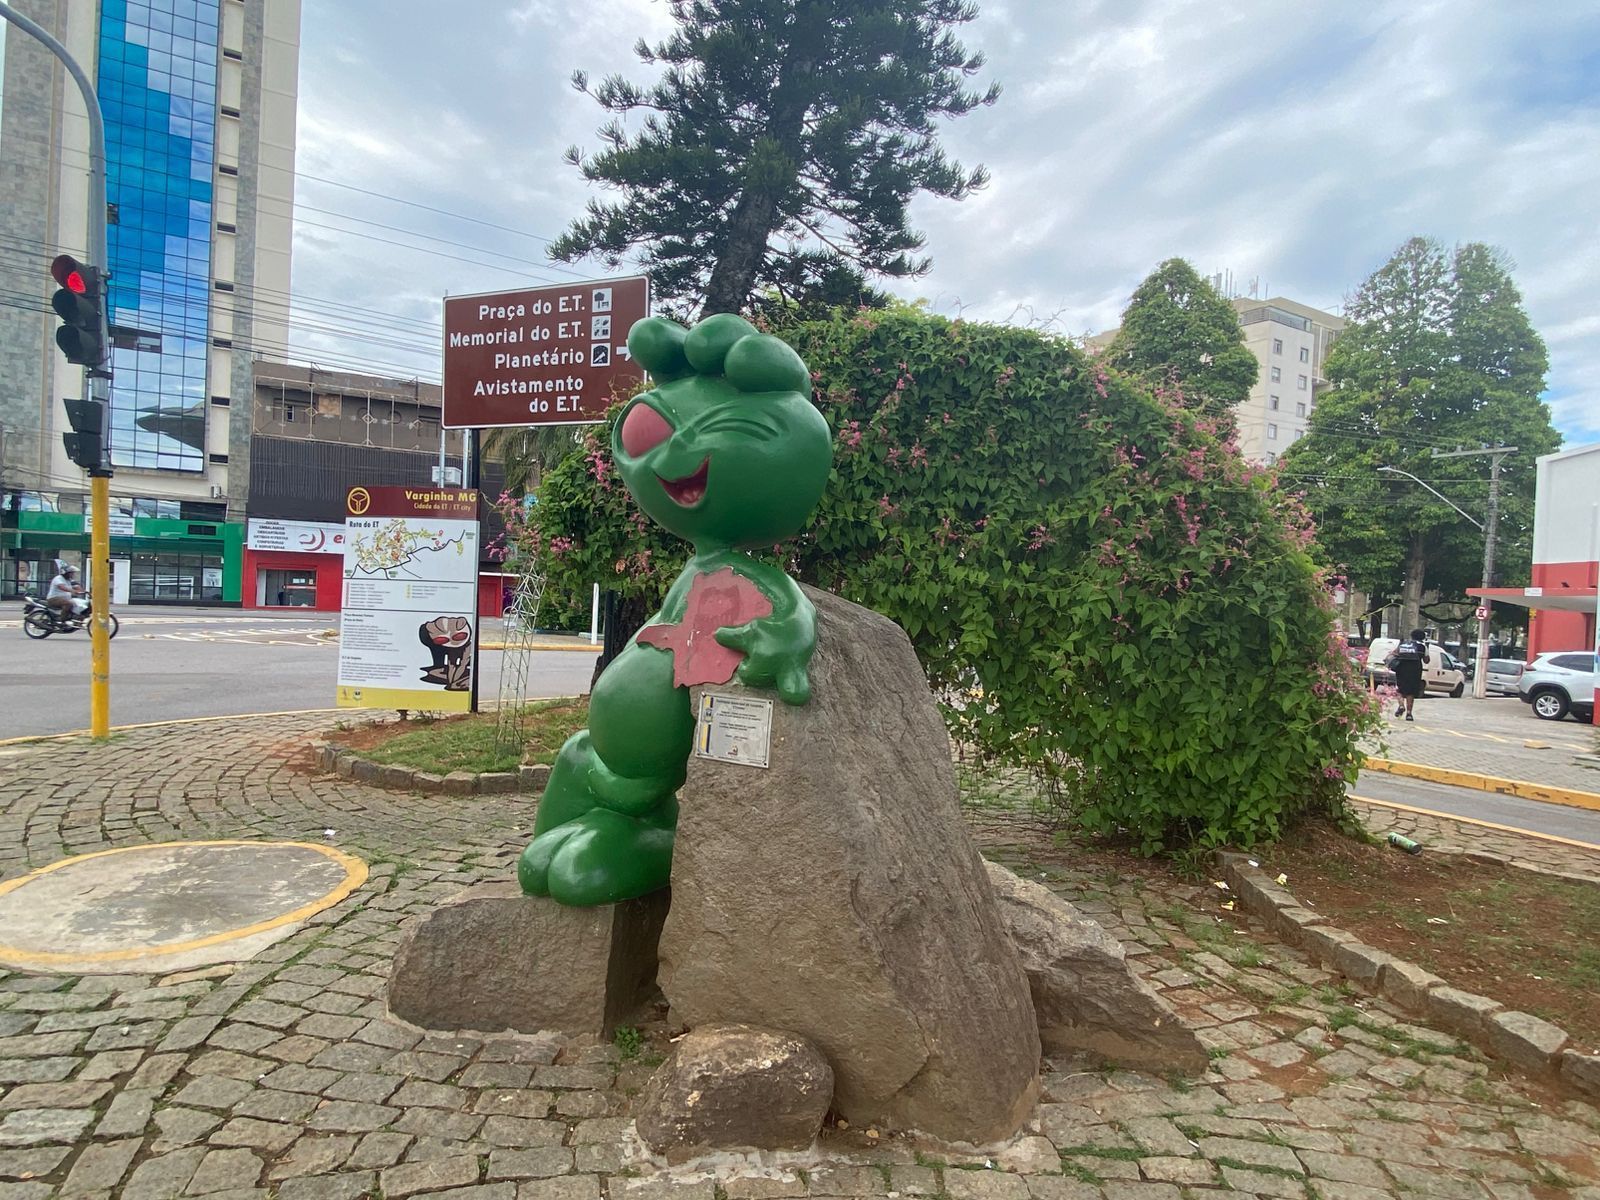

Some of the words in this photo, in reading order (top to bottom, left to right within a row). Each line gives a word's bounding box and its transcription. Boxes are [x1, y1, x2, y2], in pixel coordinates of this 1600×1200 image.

[478, 304, 525, 321] Praça
[532, 298, 552, 315] do
[558, 294, 585, 313] E.T.
[449, 327, 524, 348] Memorial
[530, 325, 551, 341] do
[558, 321, 585, 339] E.T.
[494, 347, 585, 369] Planetário
[473, 375, 584, 396] Avistamento
[529, 397, 549, 413] do
[556, 395, 583, 412] E.T.
[405, 490, 454, 502] Varginha
[458, 492, 477, 502] MG
